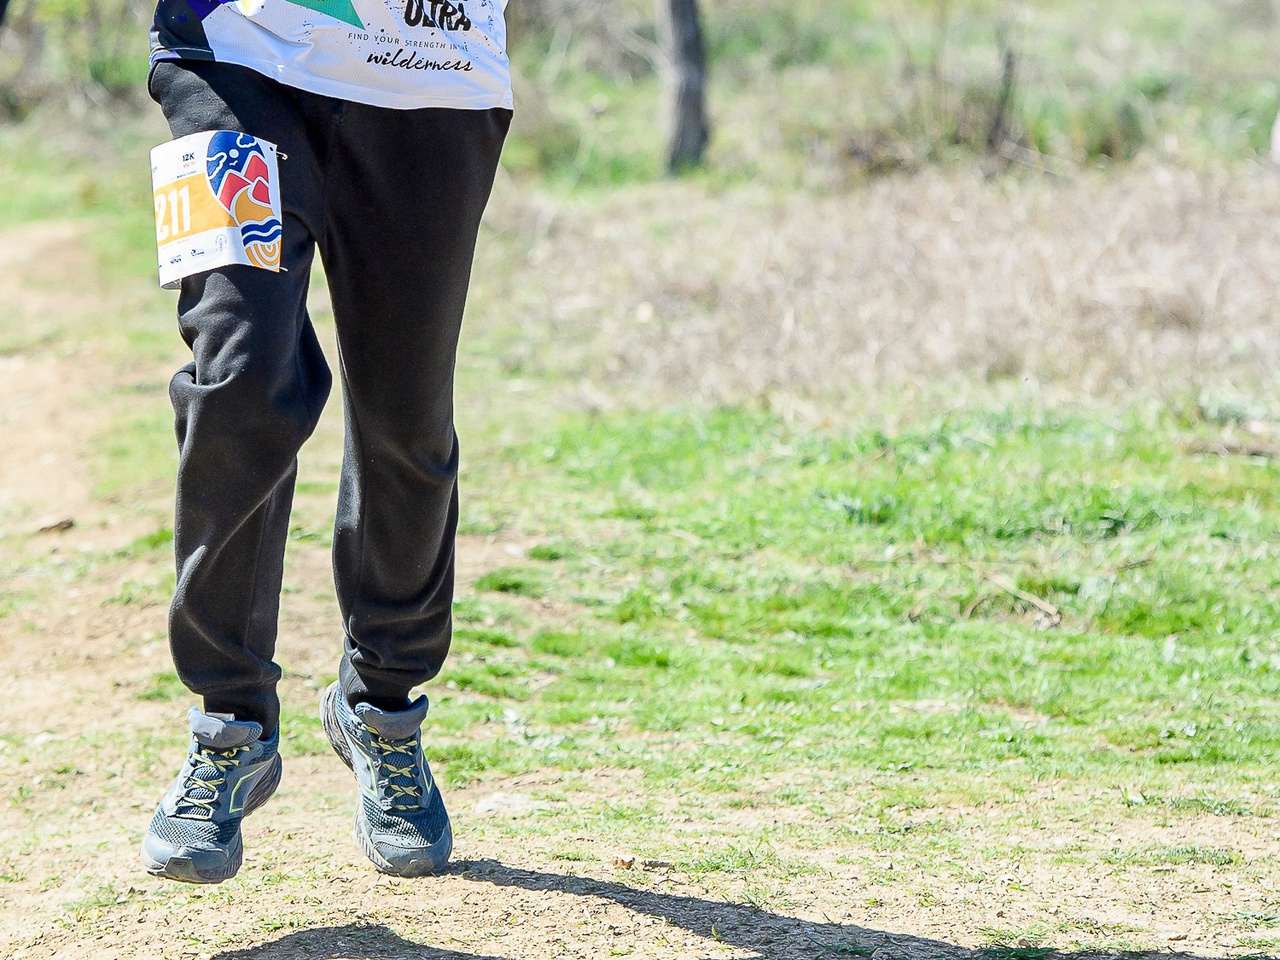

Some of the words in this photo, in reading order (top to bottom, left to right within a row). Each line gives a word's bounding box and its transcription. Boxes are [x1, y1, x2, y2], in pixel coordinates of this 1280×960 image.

[348, 32, 369, 41] FIND
[374, 35, 400, 45] YOUR
[404, 40, 447, 49] STRENGTH
[366, 48, 473, 72] wilderness
[182, 152, 195, 162] 12K
